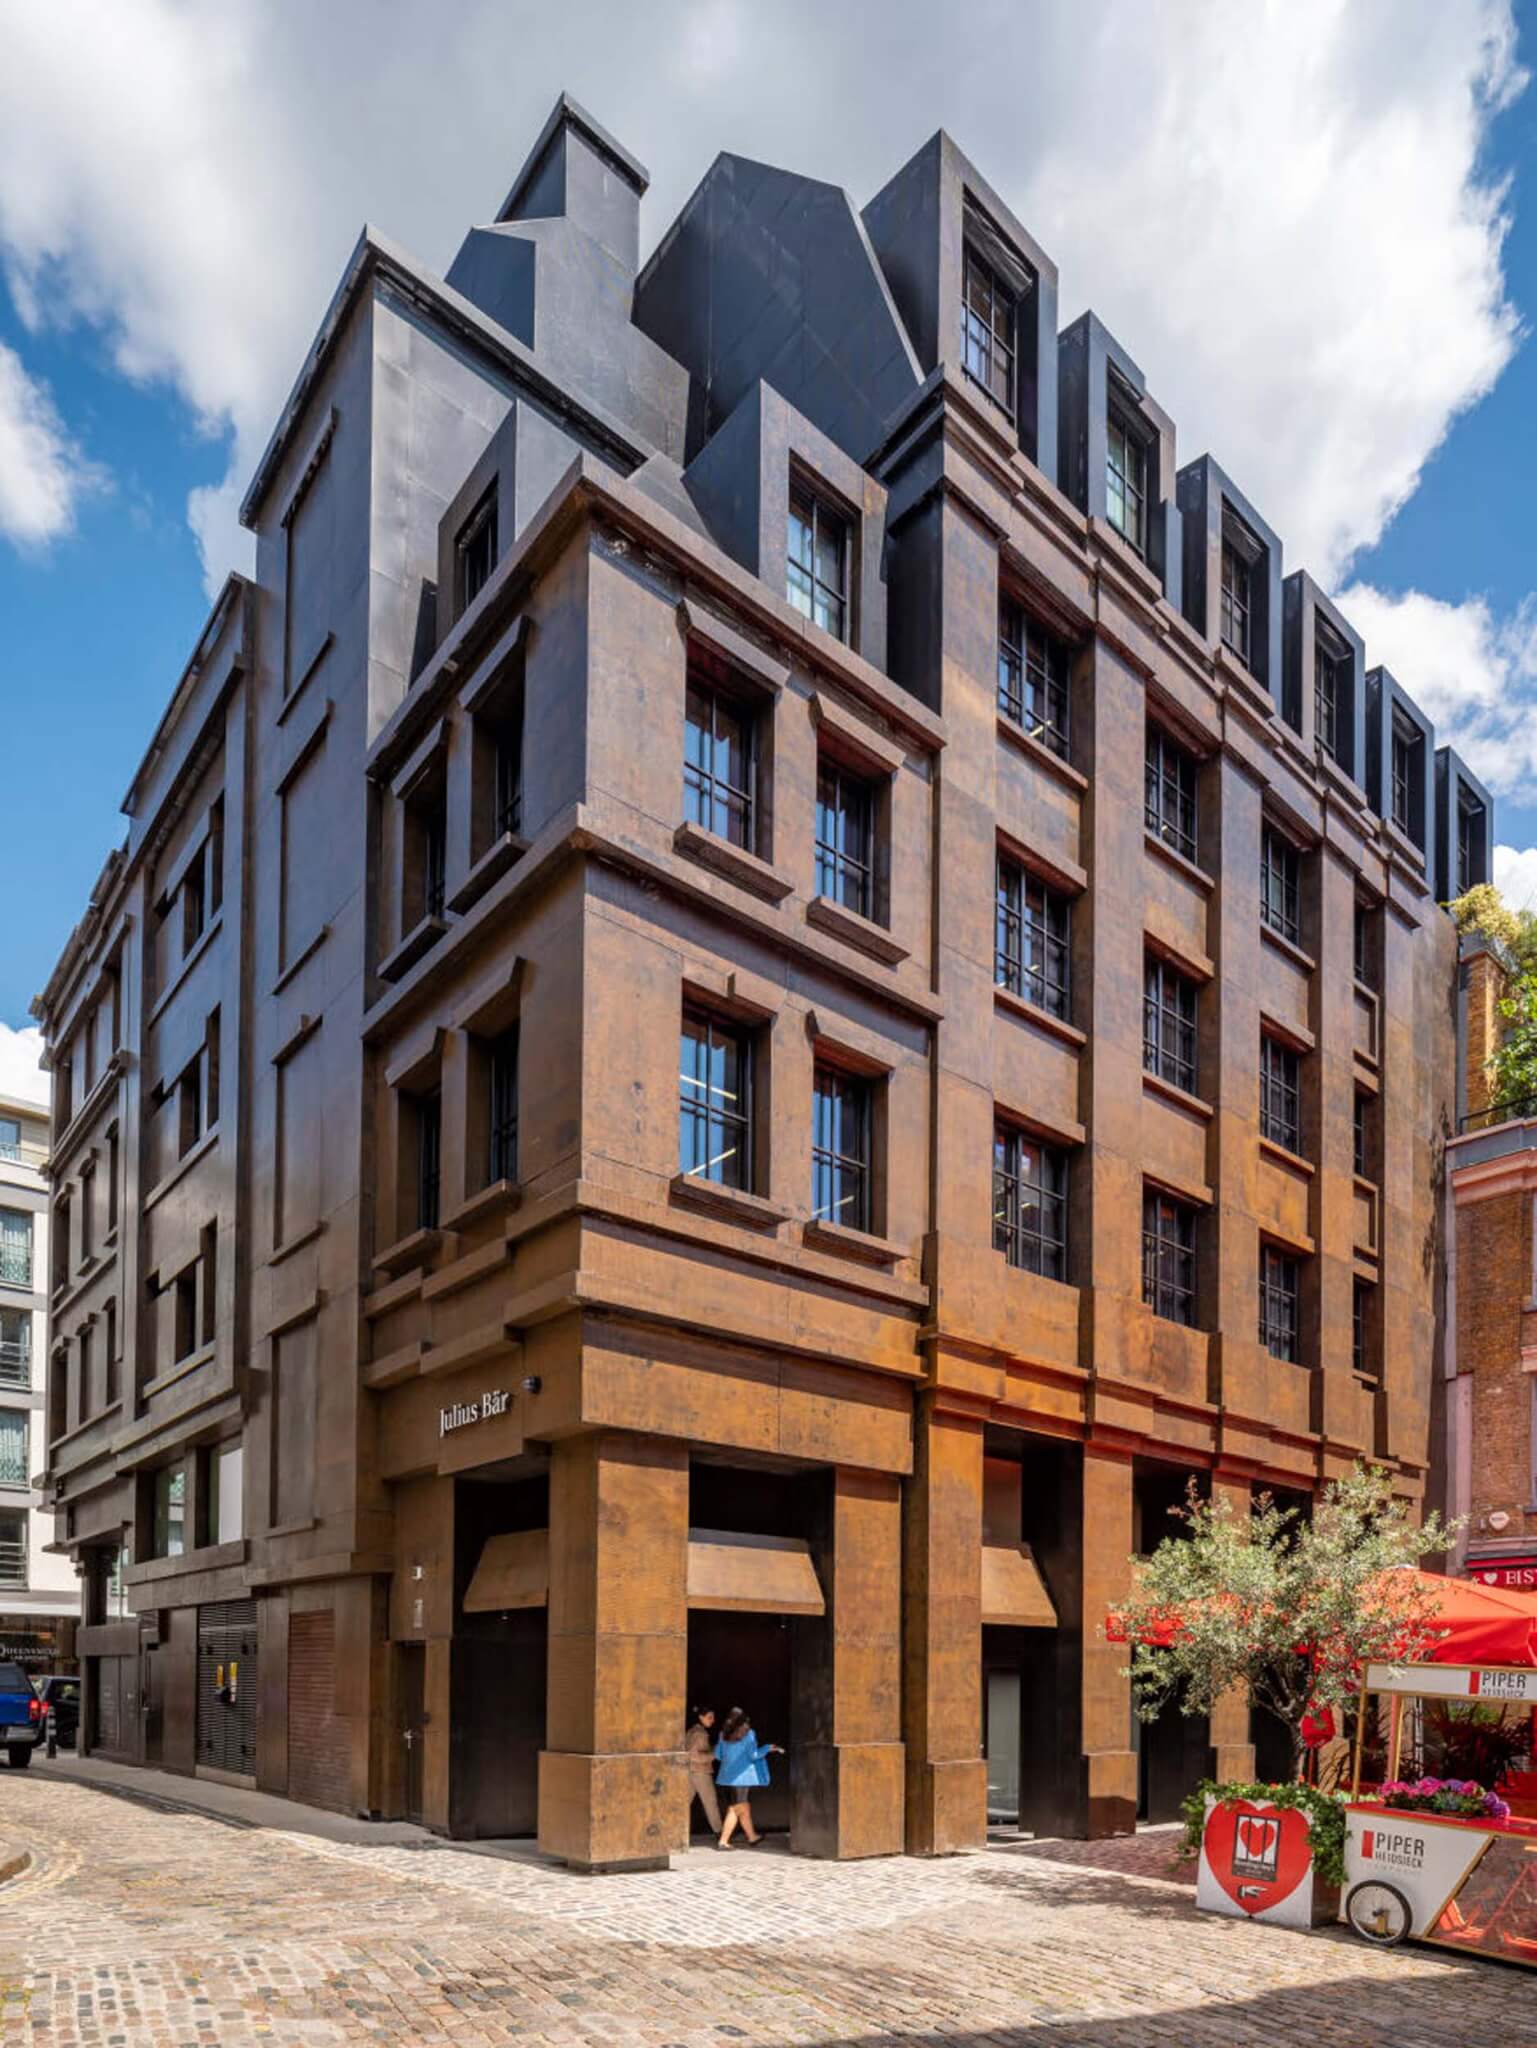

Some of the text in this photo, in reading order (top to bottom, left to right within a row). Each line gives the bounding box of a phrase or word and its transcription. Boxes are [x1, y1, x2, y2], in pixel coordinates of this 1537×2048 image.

[440, 1390, 509, 1438] Julius Bär
[1505, 1569, 1537, 1585] BIS
[1482, 1672, 1527, 1688] PIPER
[1376, 1832, 1425, 1856] PIPER
